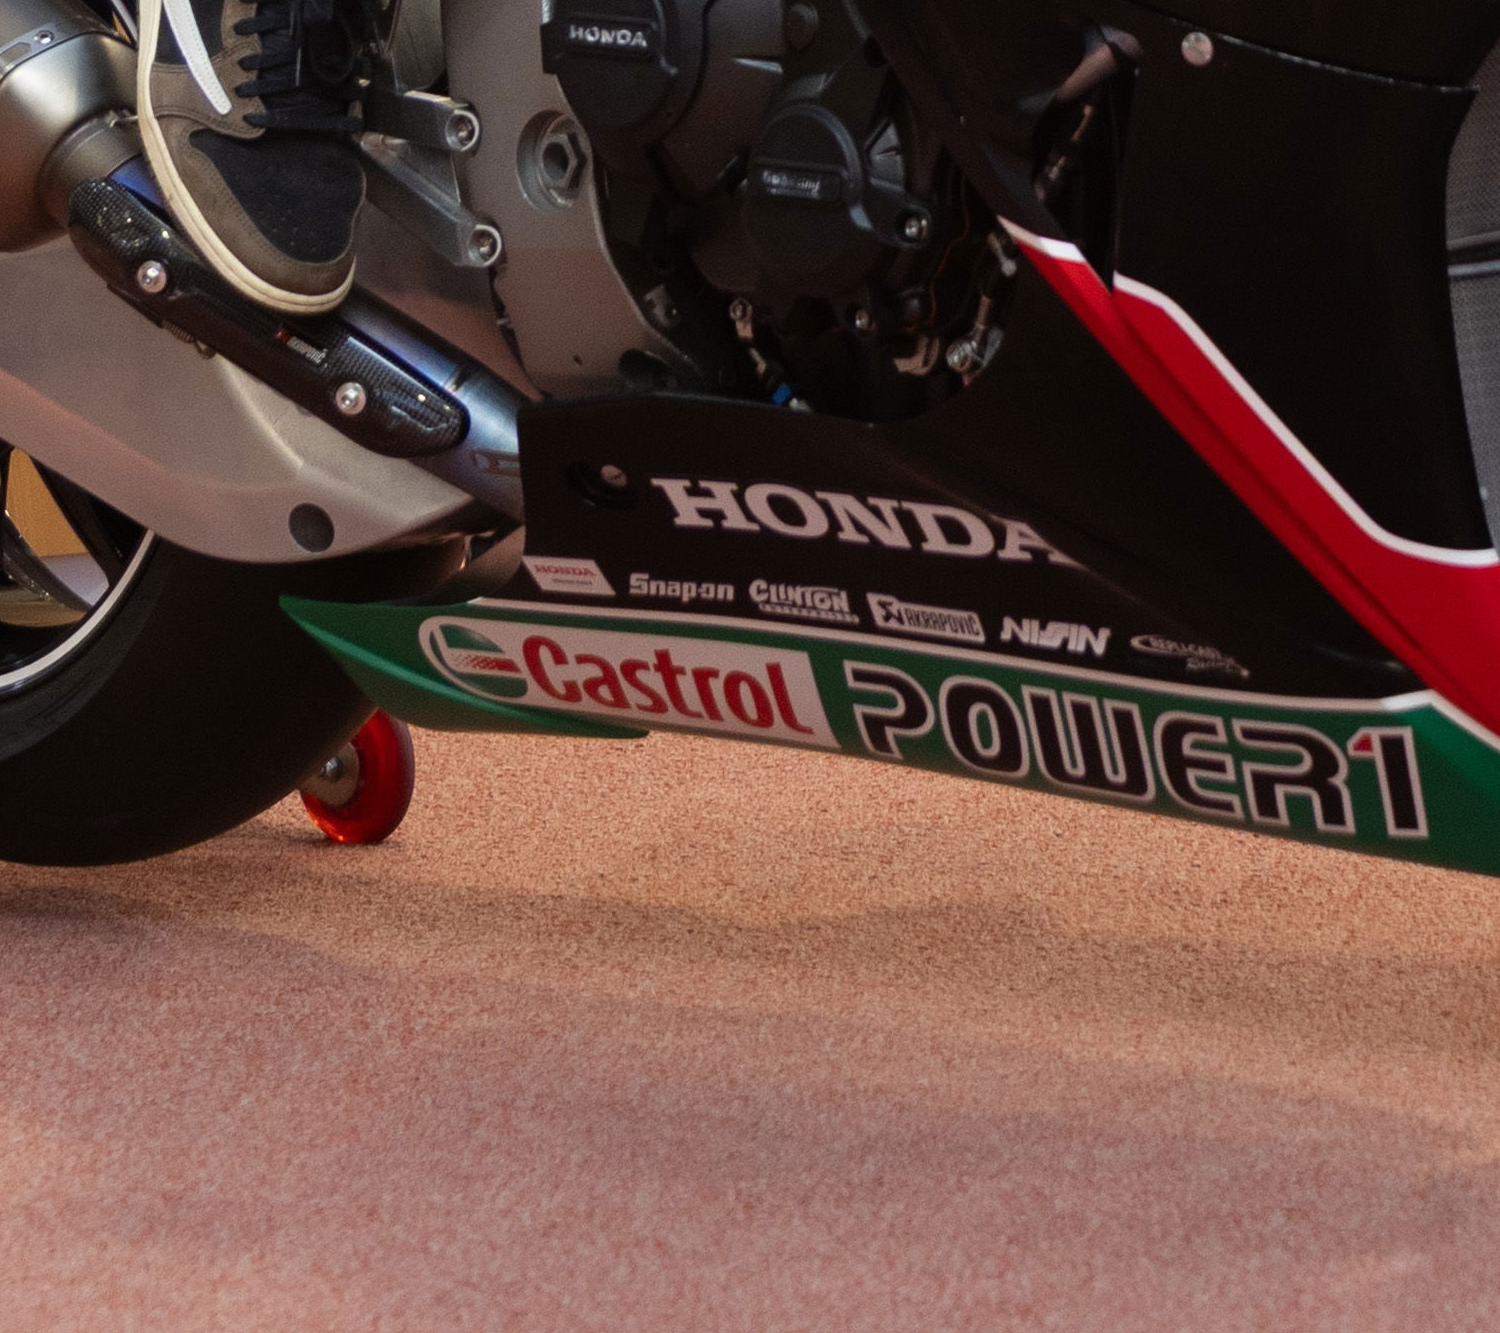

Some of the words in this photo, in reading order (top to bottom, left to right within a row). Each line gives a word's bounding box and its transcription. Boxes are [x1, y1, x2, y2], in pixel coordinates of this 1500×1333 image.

[569, 24, 648, 48] HONDA
[651, 477, 1070, 566] HONDA
[534, 563, 598, 577] HONDA
[748, 578, 850, 613] CLINTON
[522, 634, 814, 735] Castrol
[843, 658, 1429, 841] POWER1
